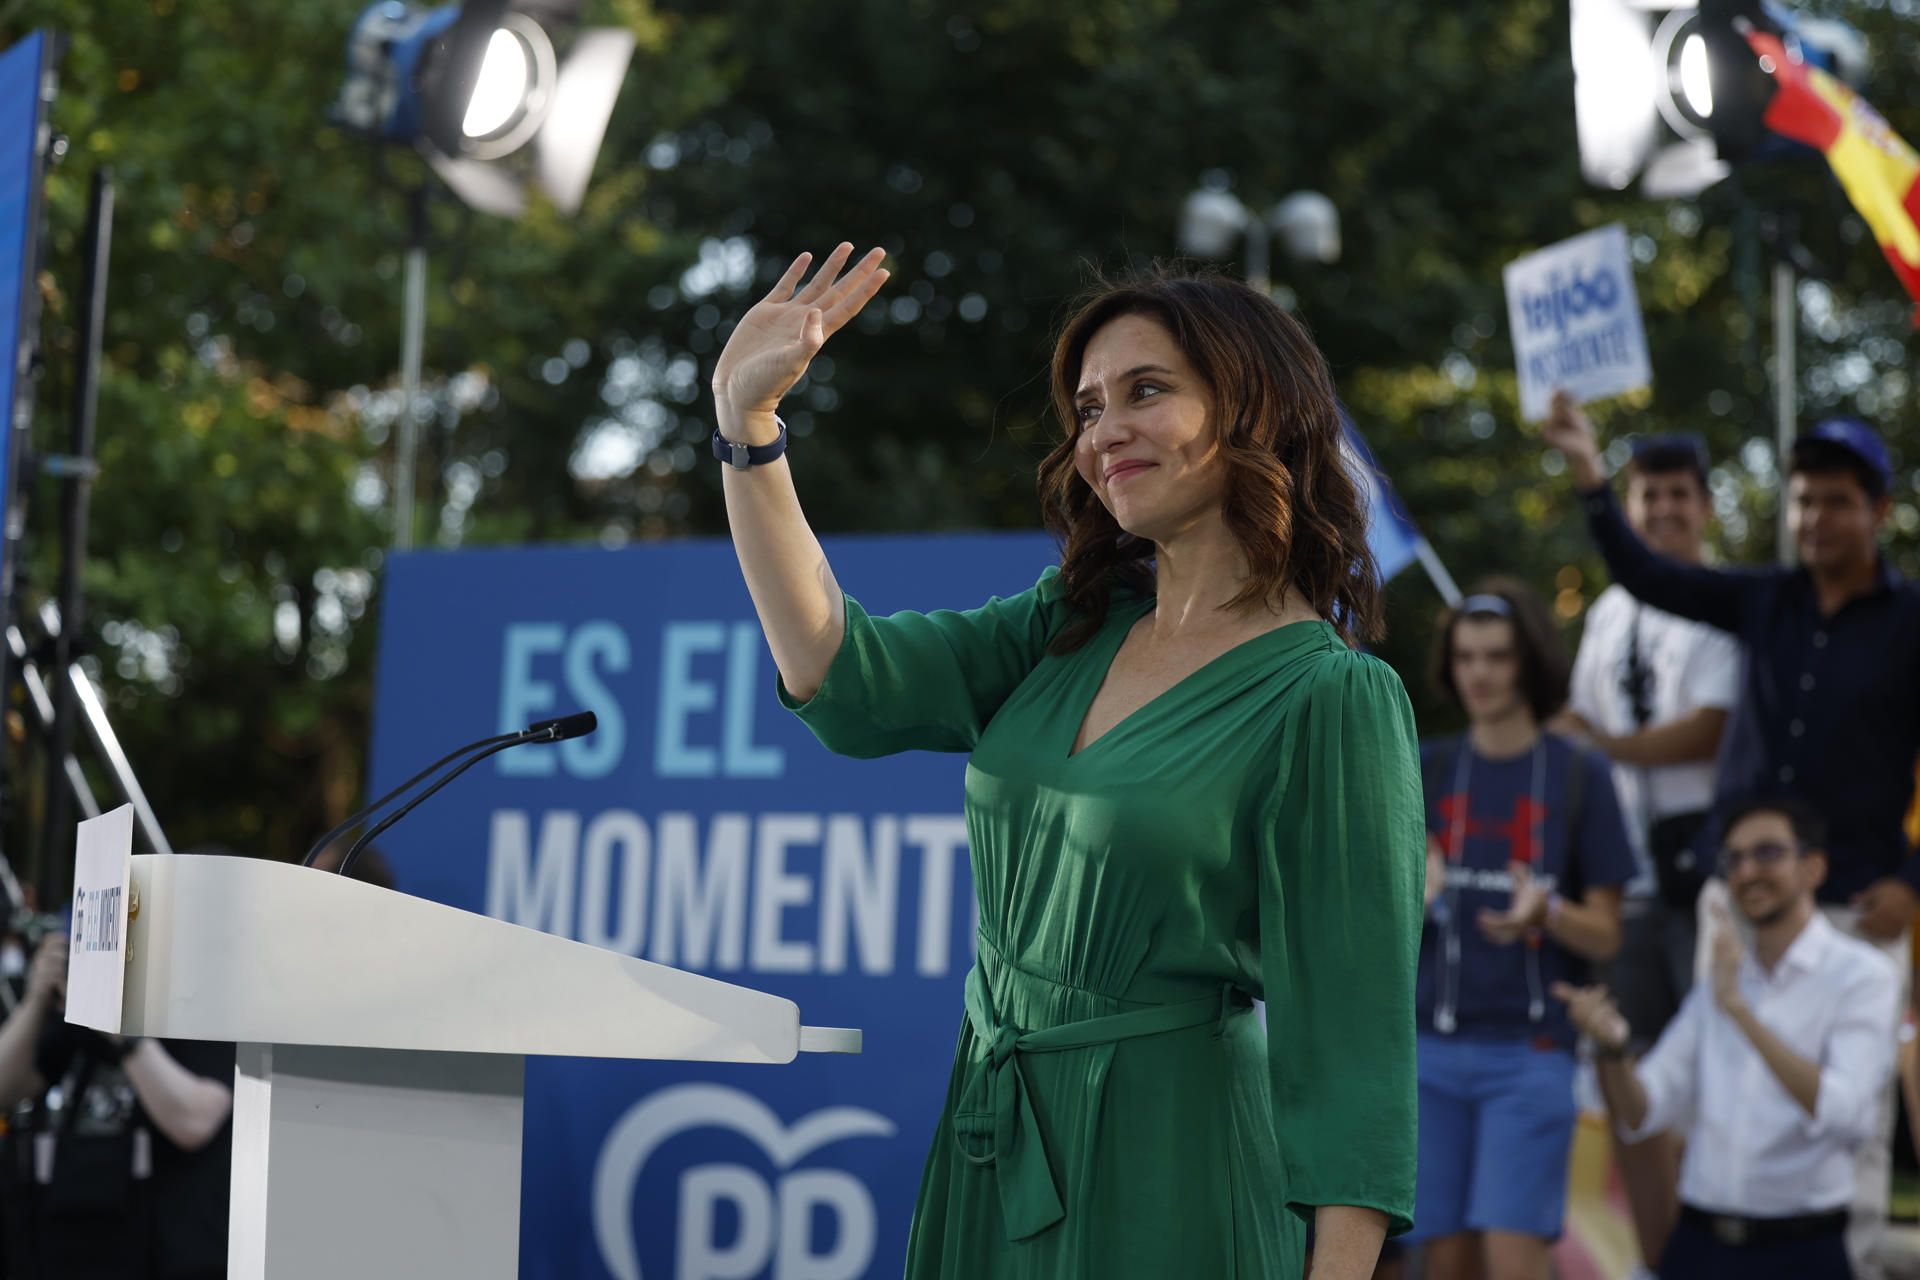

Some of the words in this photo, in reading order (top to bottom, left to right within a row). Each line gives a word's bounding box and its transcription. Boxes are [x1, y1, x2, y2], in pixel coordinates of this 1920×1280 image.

[497, 622, 630, 777] ES
[655, 622, 784, 777] EL
[487, 812, 979, 975] MOMENT
